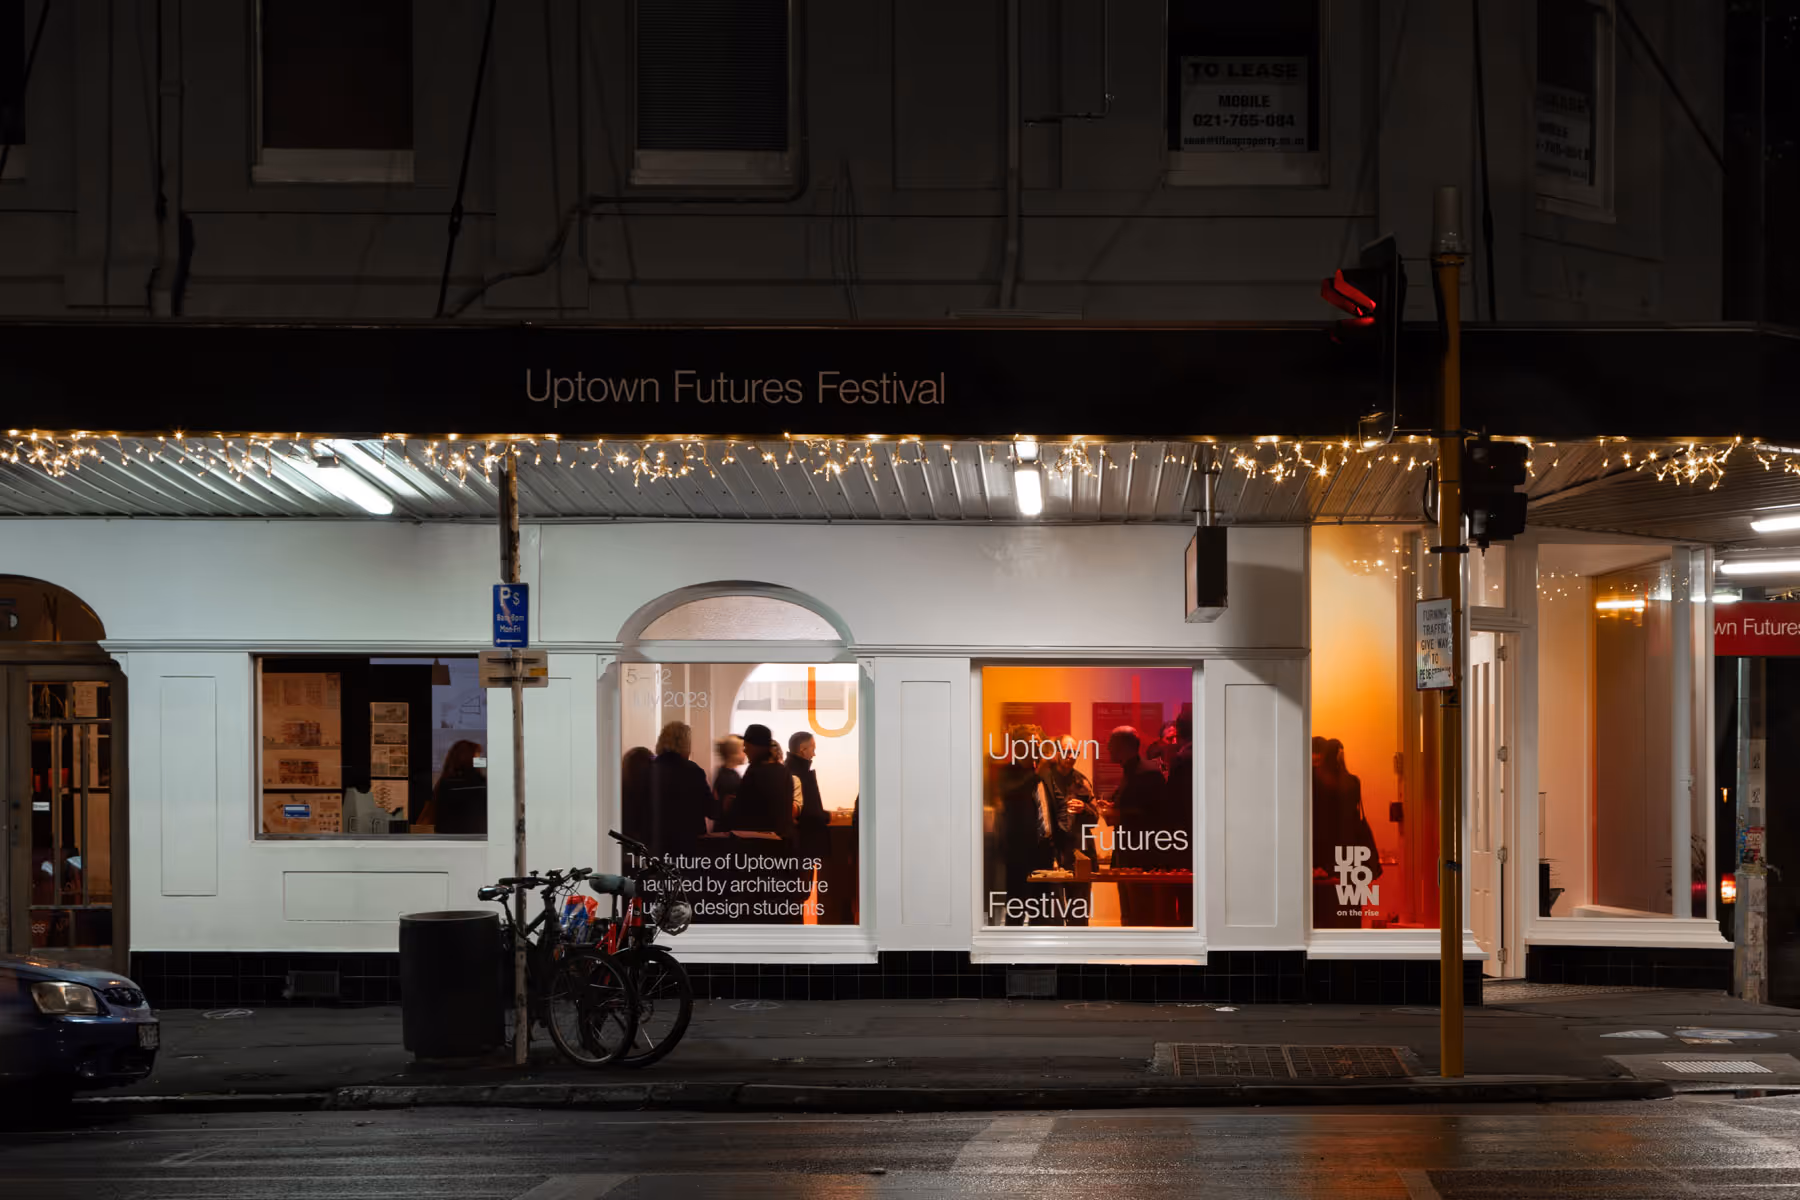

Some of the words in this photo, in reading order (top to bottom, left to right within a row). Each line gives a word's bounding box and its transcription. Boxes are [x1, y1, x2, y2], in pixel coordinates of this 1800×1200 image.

[1189, 63, 1218, 79] TO
[1228, 63, 1298, 77] LEASE
[1219, 95, 1270, 108] MOBILE
[526, 369, 659, 408] Uptown
[674, 371, 802, 403] Futures
[818, 372, 945, 404] Festival
[1423, 608, 1447, 621] TURNING
[1423, 623, 1447, 636] TRAFFIC
[1421, 639, 1434, 651] GIVE
[1437, 638, 1448, 649] WAY
[1431, 653, 1439, 665] TO
[664, 691, 708, 708] 2023
[989, 732, 1100, 765] Uptown
[1081, 824, 1189, 851] Futures
[663, 852, 711, 869] future
[714, 853, 733, 869] of
[734, 853, 799, 873] Uptown
[802, 857, 822, 869] as
[627, 876, 703, 895] agined
[706, 876, 729, 895] by
[730, 876, 828, 893] architecture
[694, 899, 750, 918] design
[753, 899, 825, 916] students
[989, 891, 1094, 919] Festival
